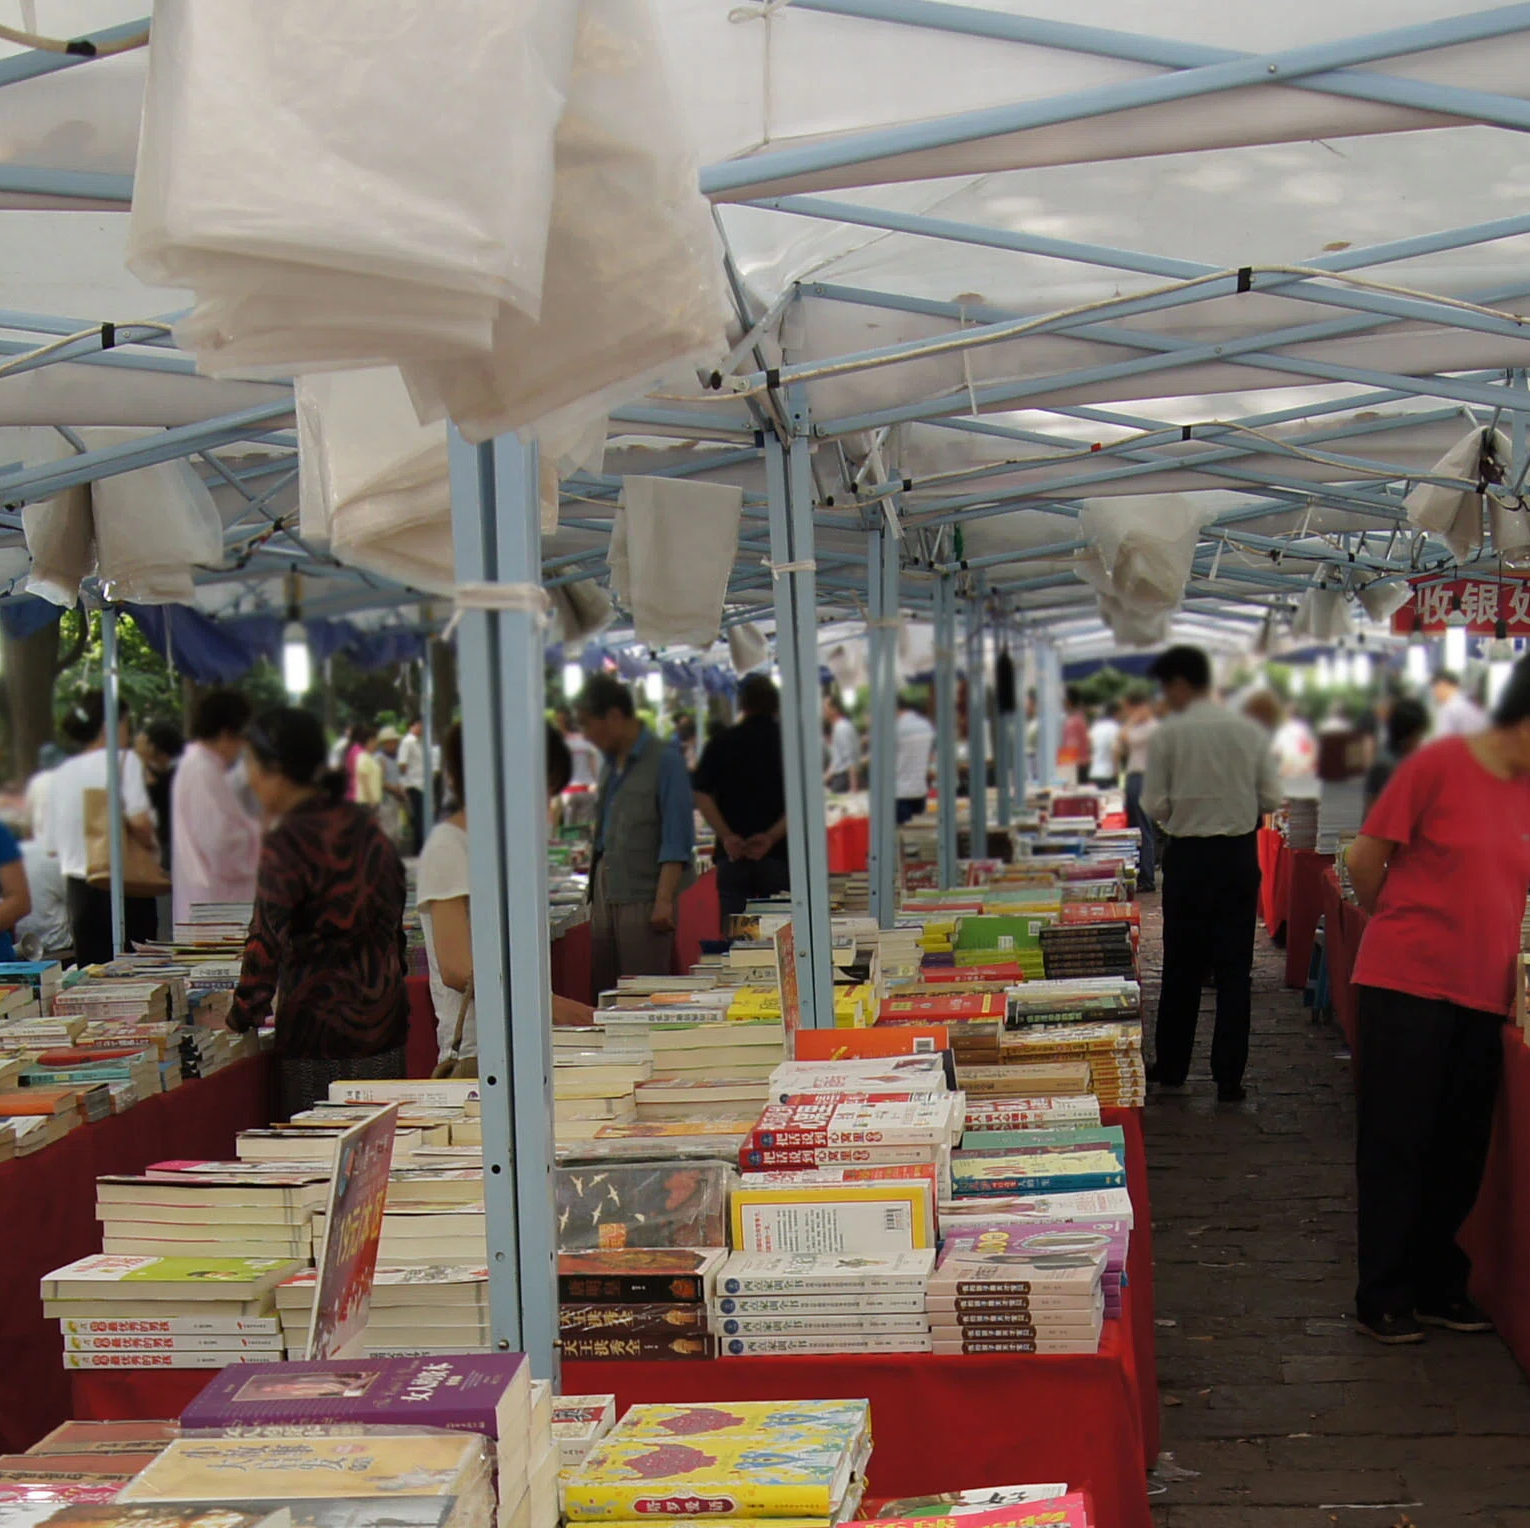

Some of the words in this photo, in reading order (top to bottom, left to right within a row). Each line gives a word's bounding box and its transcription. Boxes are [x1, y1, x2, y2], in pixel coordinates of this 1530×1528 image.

[563, 1337, 642, 1357] 天王洪秀全
